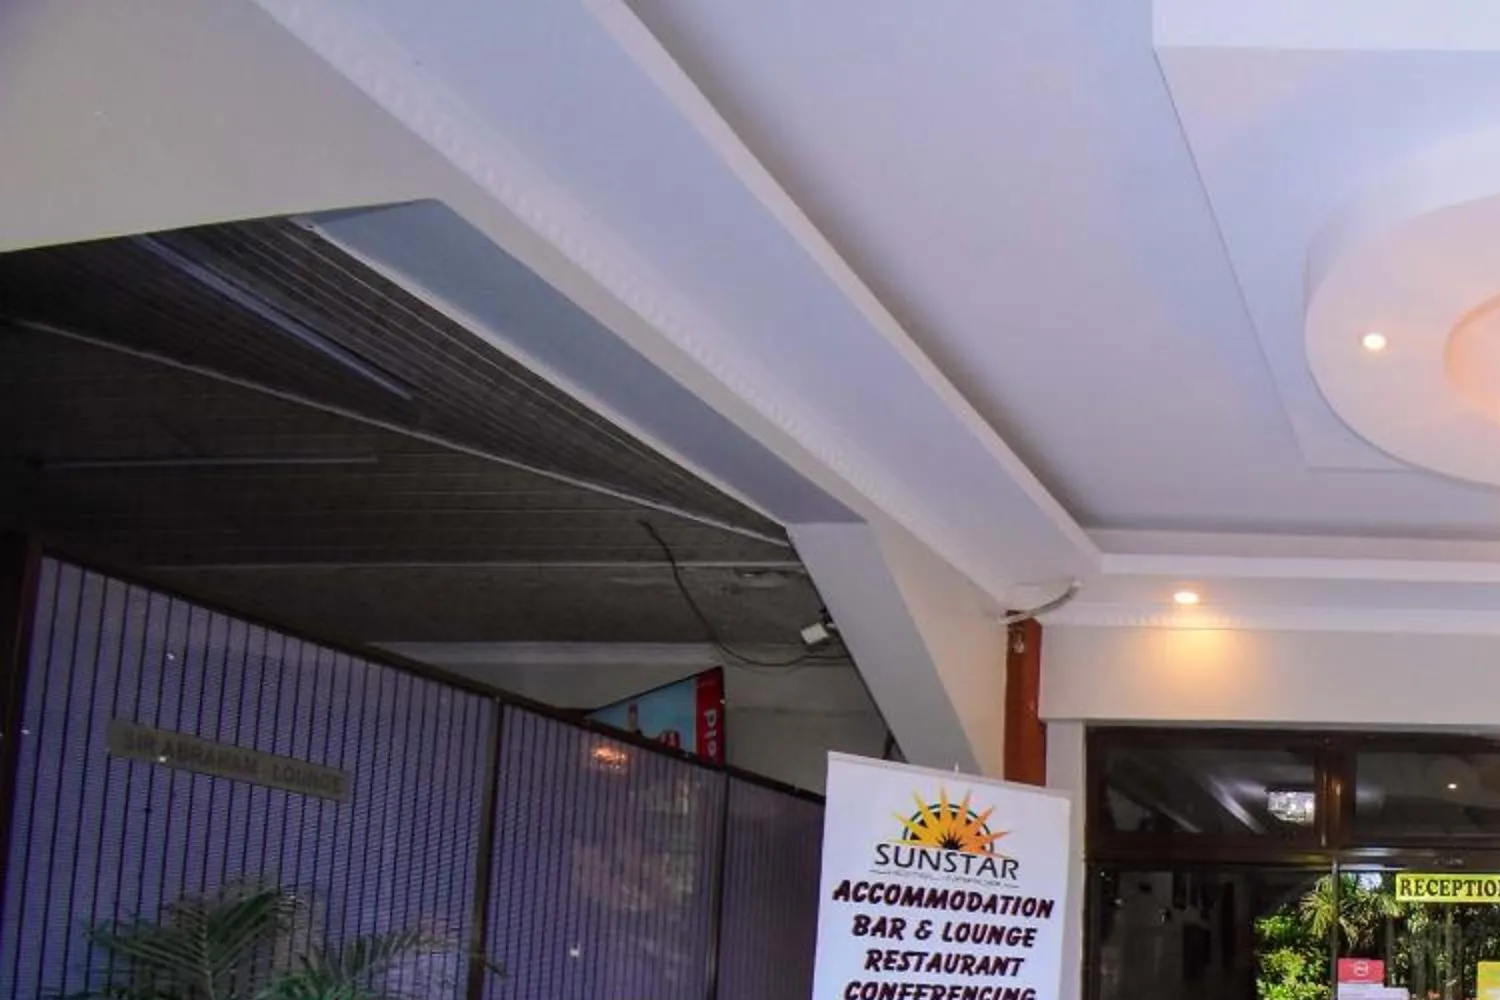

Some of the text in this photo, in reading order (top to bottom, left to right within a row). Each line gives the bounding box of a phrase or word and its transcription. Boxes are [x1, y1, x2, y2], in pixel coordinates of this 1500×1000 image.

[124, 730, 342, 794] SIR ABRAHAM LOUNGE
[874, 843, 1020, 880] SUNSTAR
[832, 879, 1055, 919] ACCOMMODATION
[852, 914, 1038, 948] BAR & LOUNGE
[864, 950, 1025, 977] RESTAURANT
